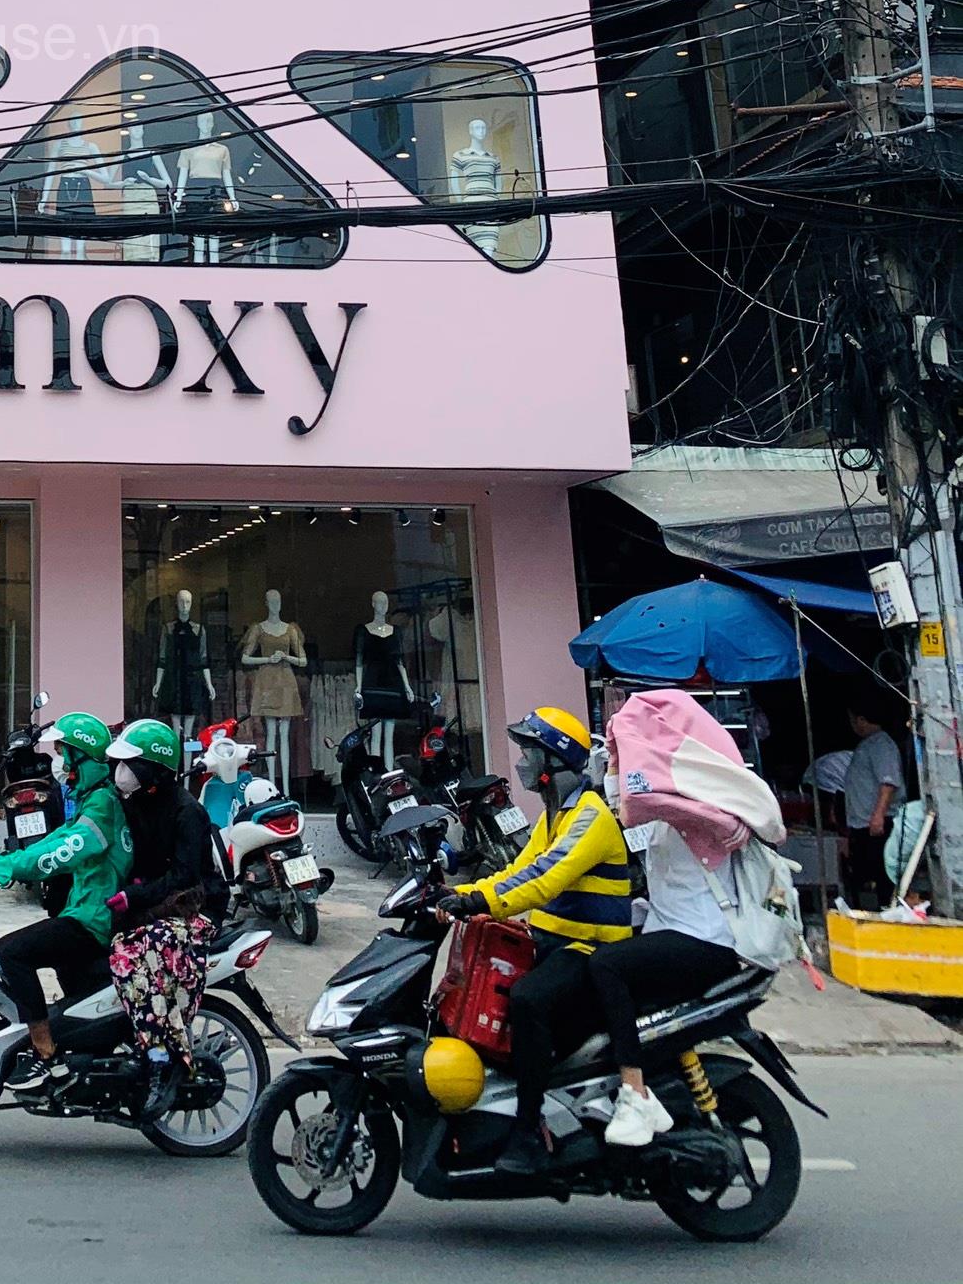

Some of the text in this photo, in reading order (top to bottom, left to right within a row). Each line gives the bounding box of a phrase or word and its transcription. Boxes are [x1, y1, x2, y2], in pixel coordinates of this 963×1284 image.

[925, 633, 939, 645] 15
[73, 729, 97, 747] Grab
[150, 742, 174, 757] Grab
[37, 834, 85, 875] Grab
[362, 1052, 398, 1063] HONDA
